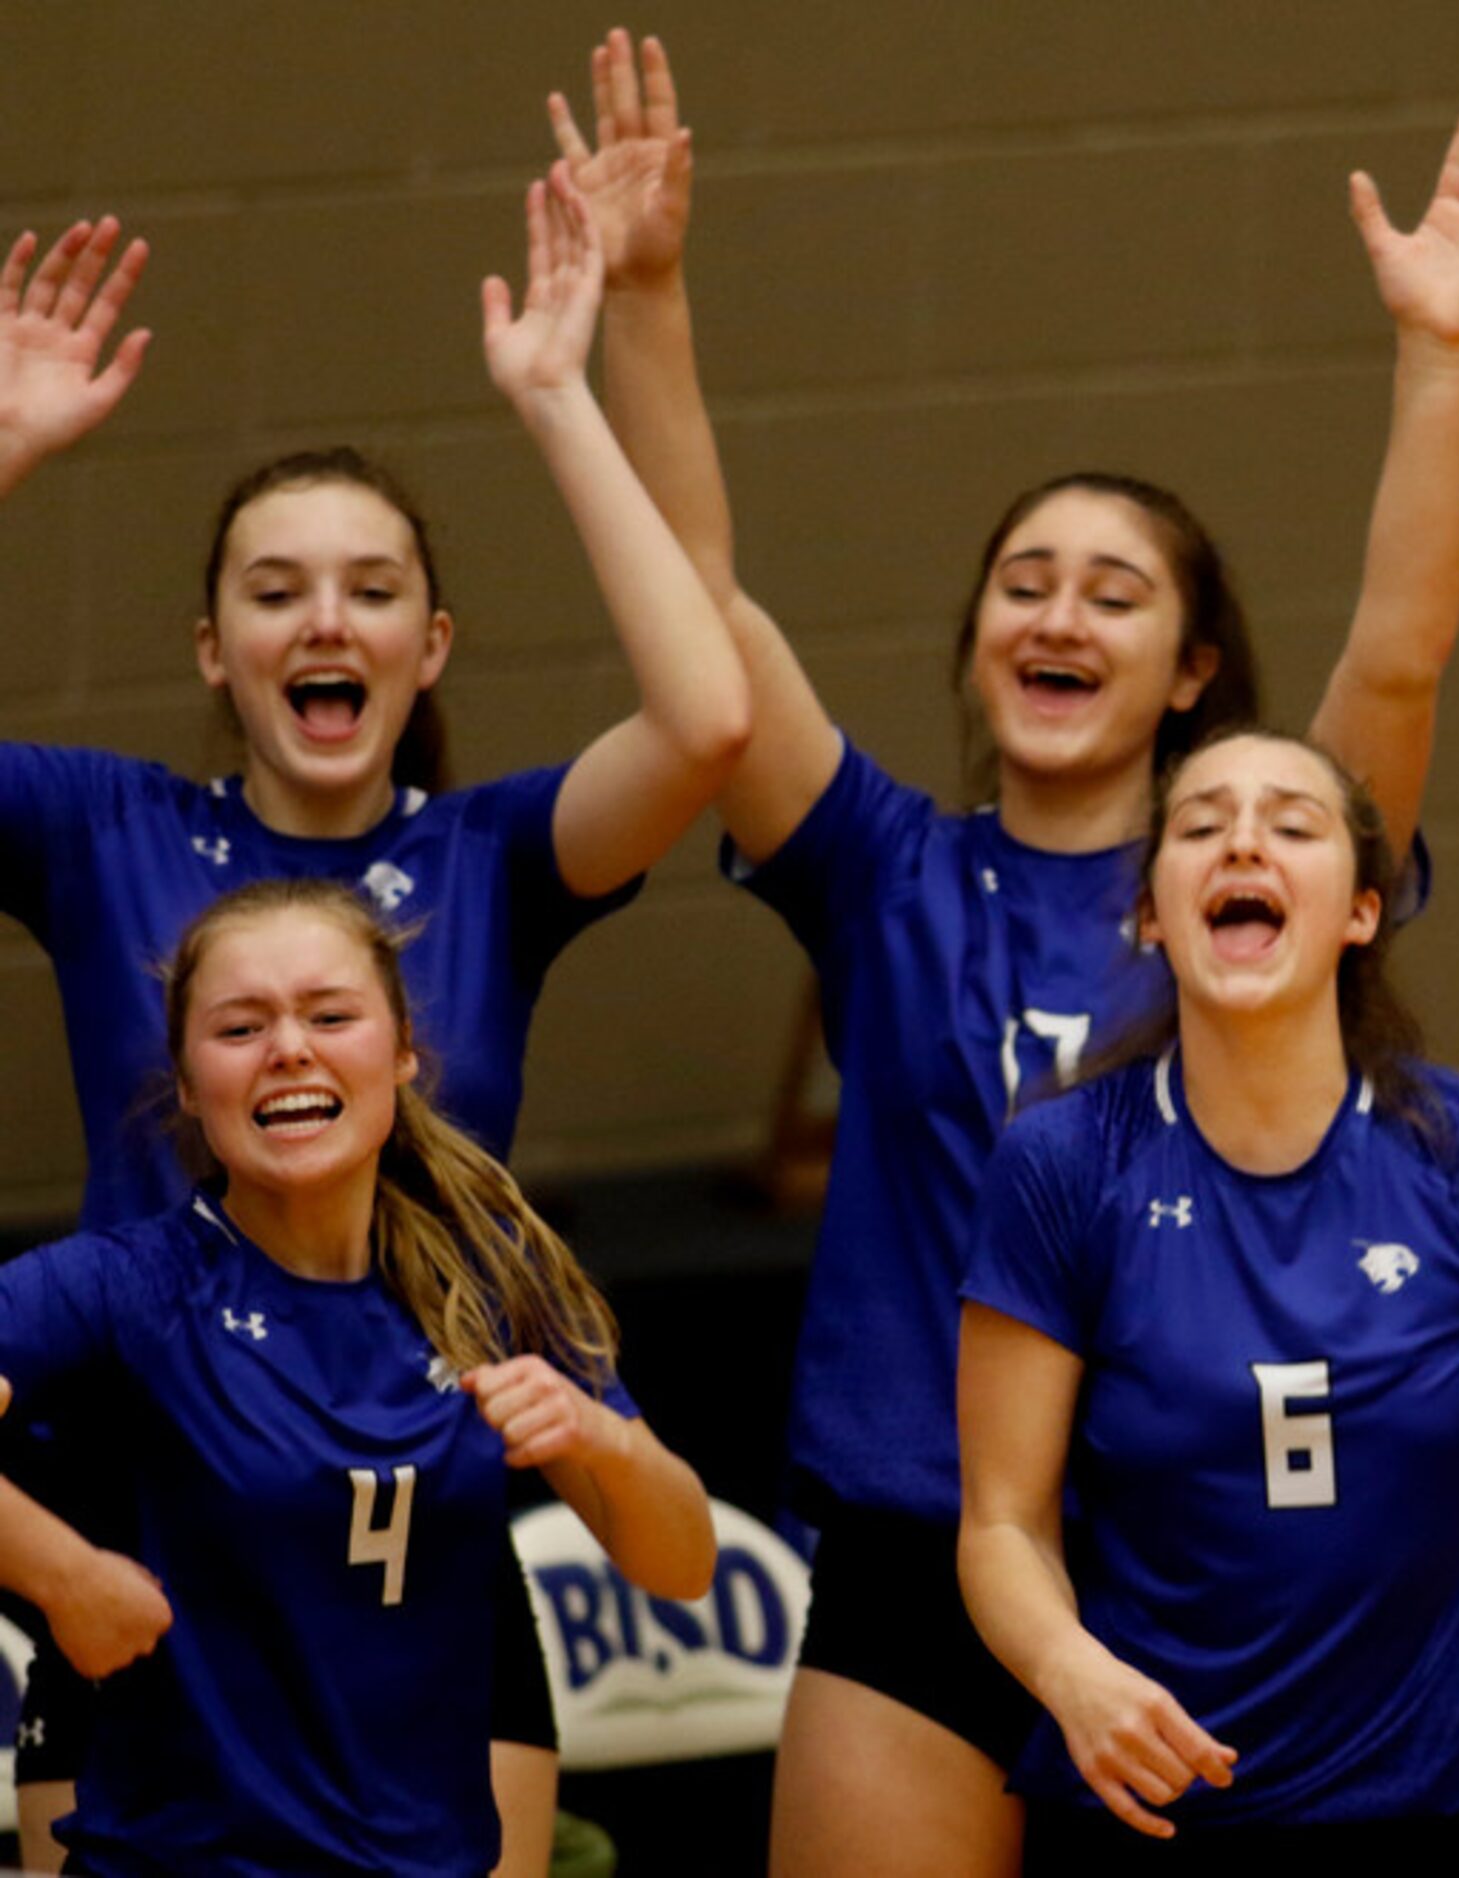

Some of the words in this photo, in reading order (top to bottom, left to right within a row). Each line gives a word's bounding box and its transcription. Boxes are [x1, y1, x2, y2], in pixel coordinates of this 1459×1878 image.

[1002, 1008, 1092, 1118] 17
[1254, 1361, 1337, 1508] 6
[347, 1465, 416, 1605] 4
